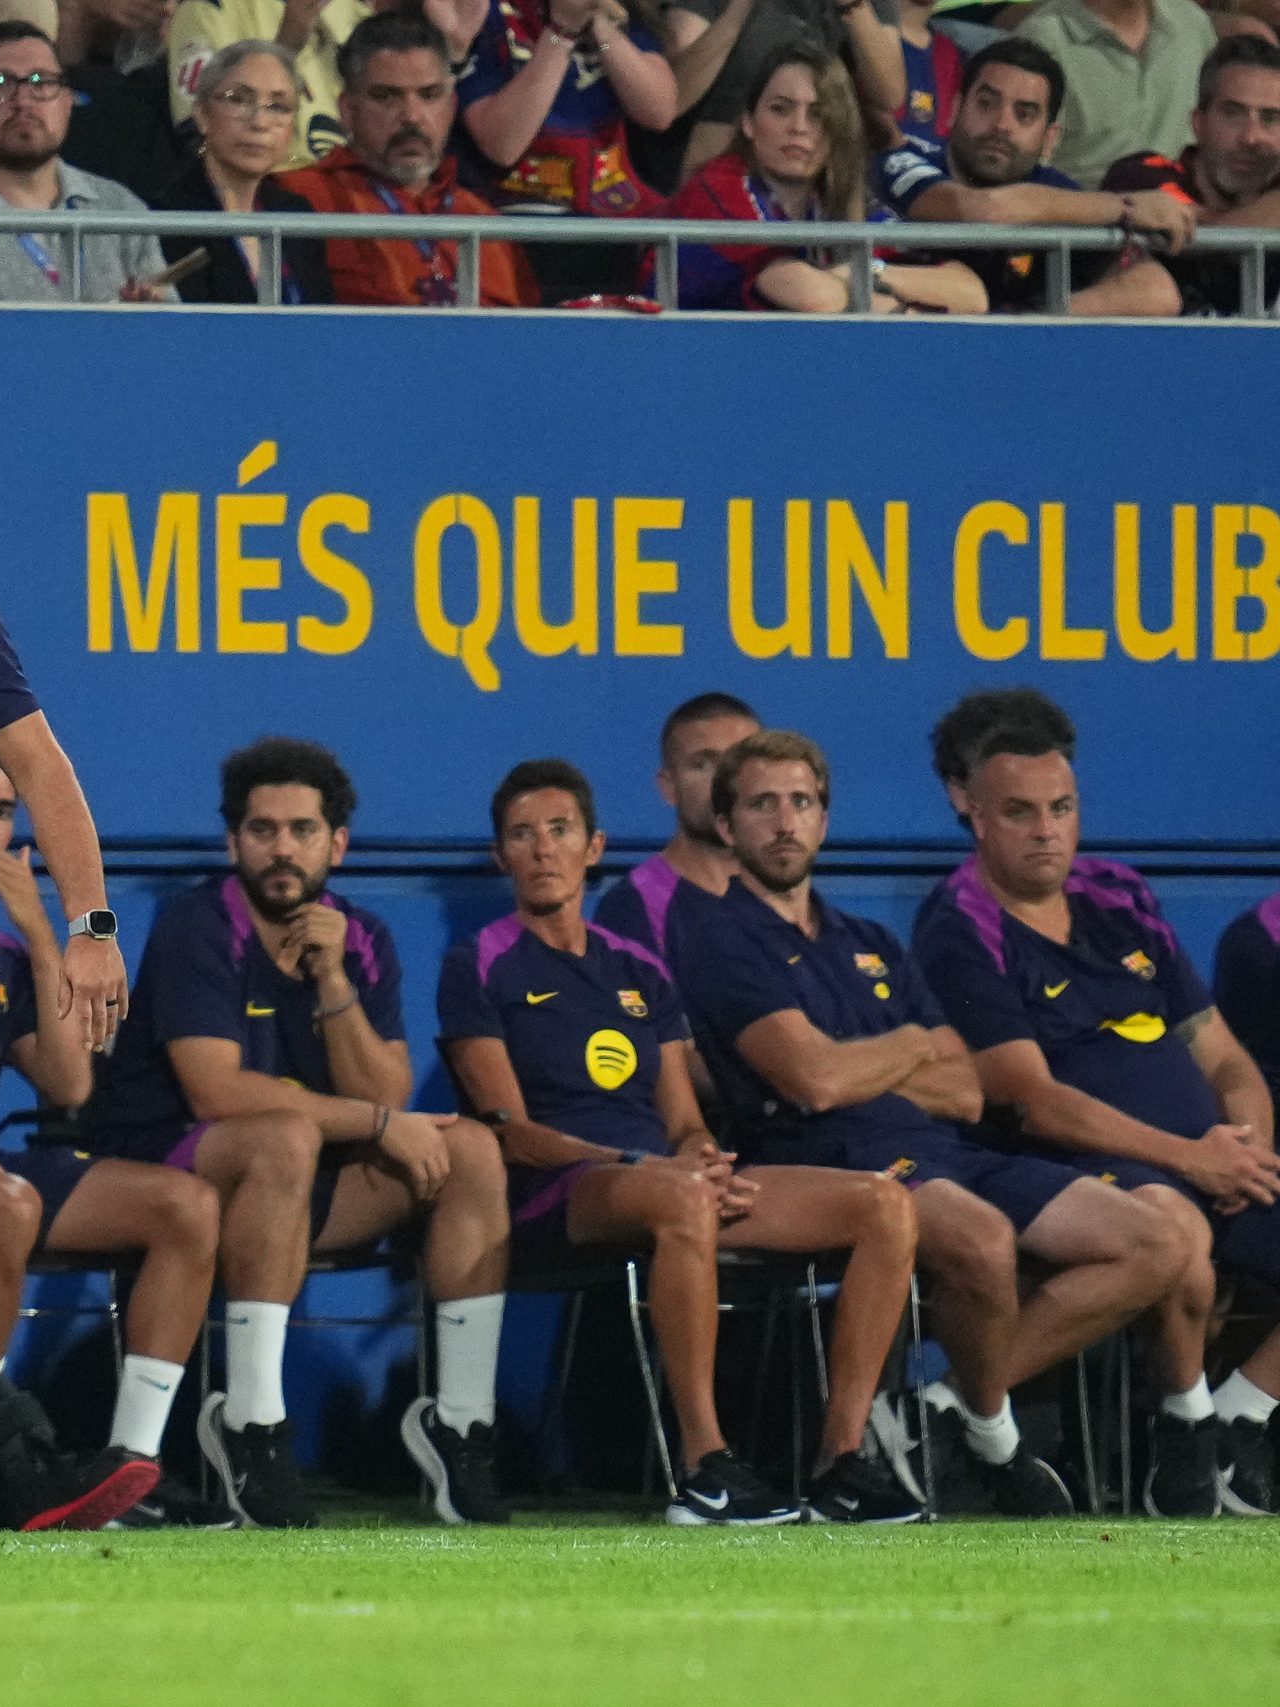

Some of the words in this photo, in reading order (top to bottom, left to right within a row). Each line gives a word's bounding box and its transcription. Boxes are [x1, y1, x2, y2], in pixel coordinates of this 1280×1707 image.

[87, 439, 374, 654] MÉS
[414, 494, 685, 691] QUE
[727, 498, 910, 659] UN
[953, 501, 1280, 661] CLUB
